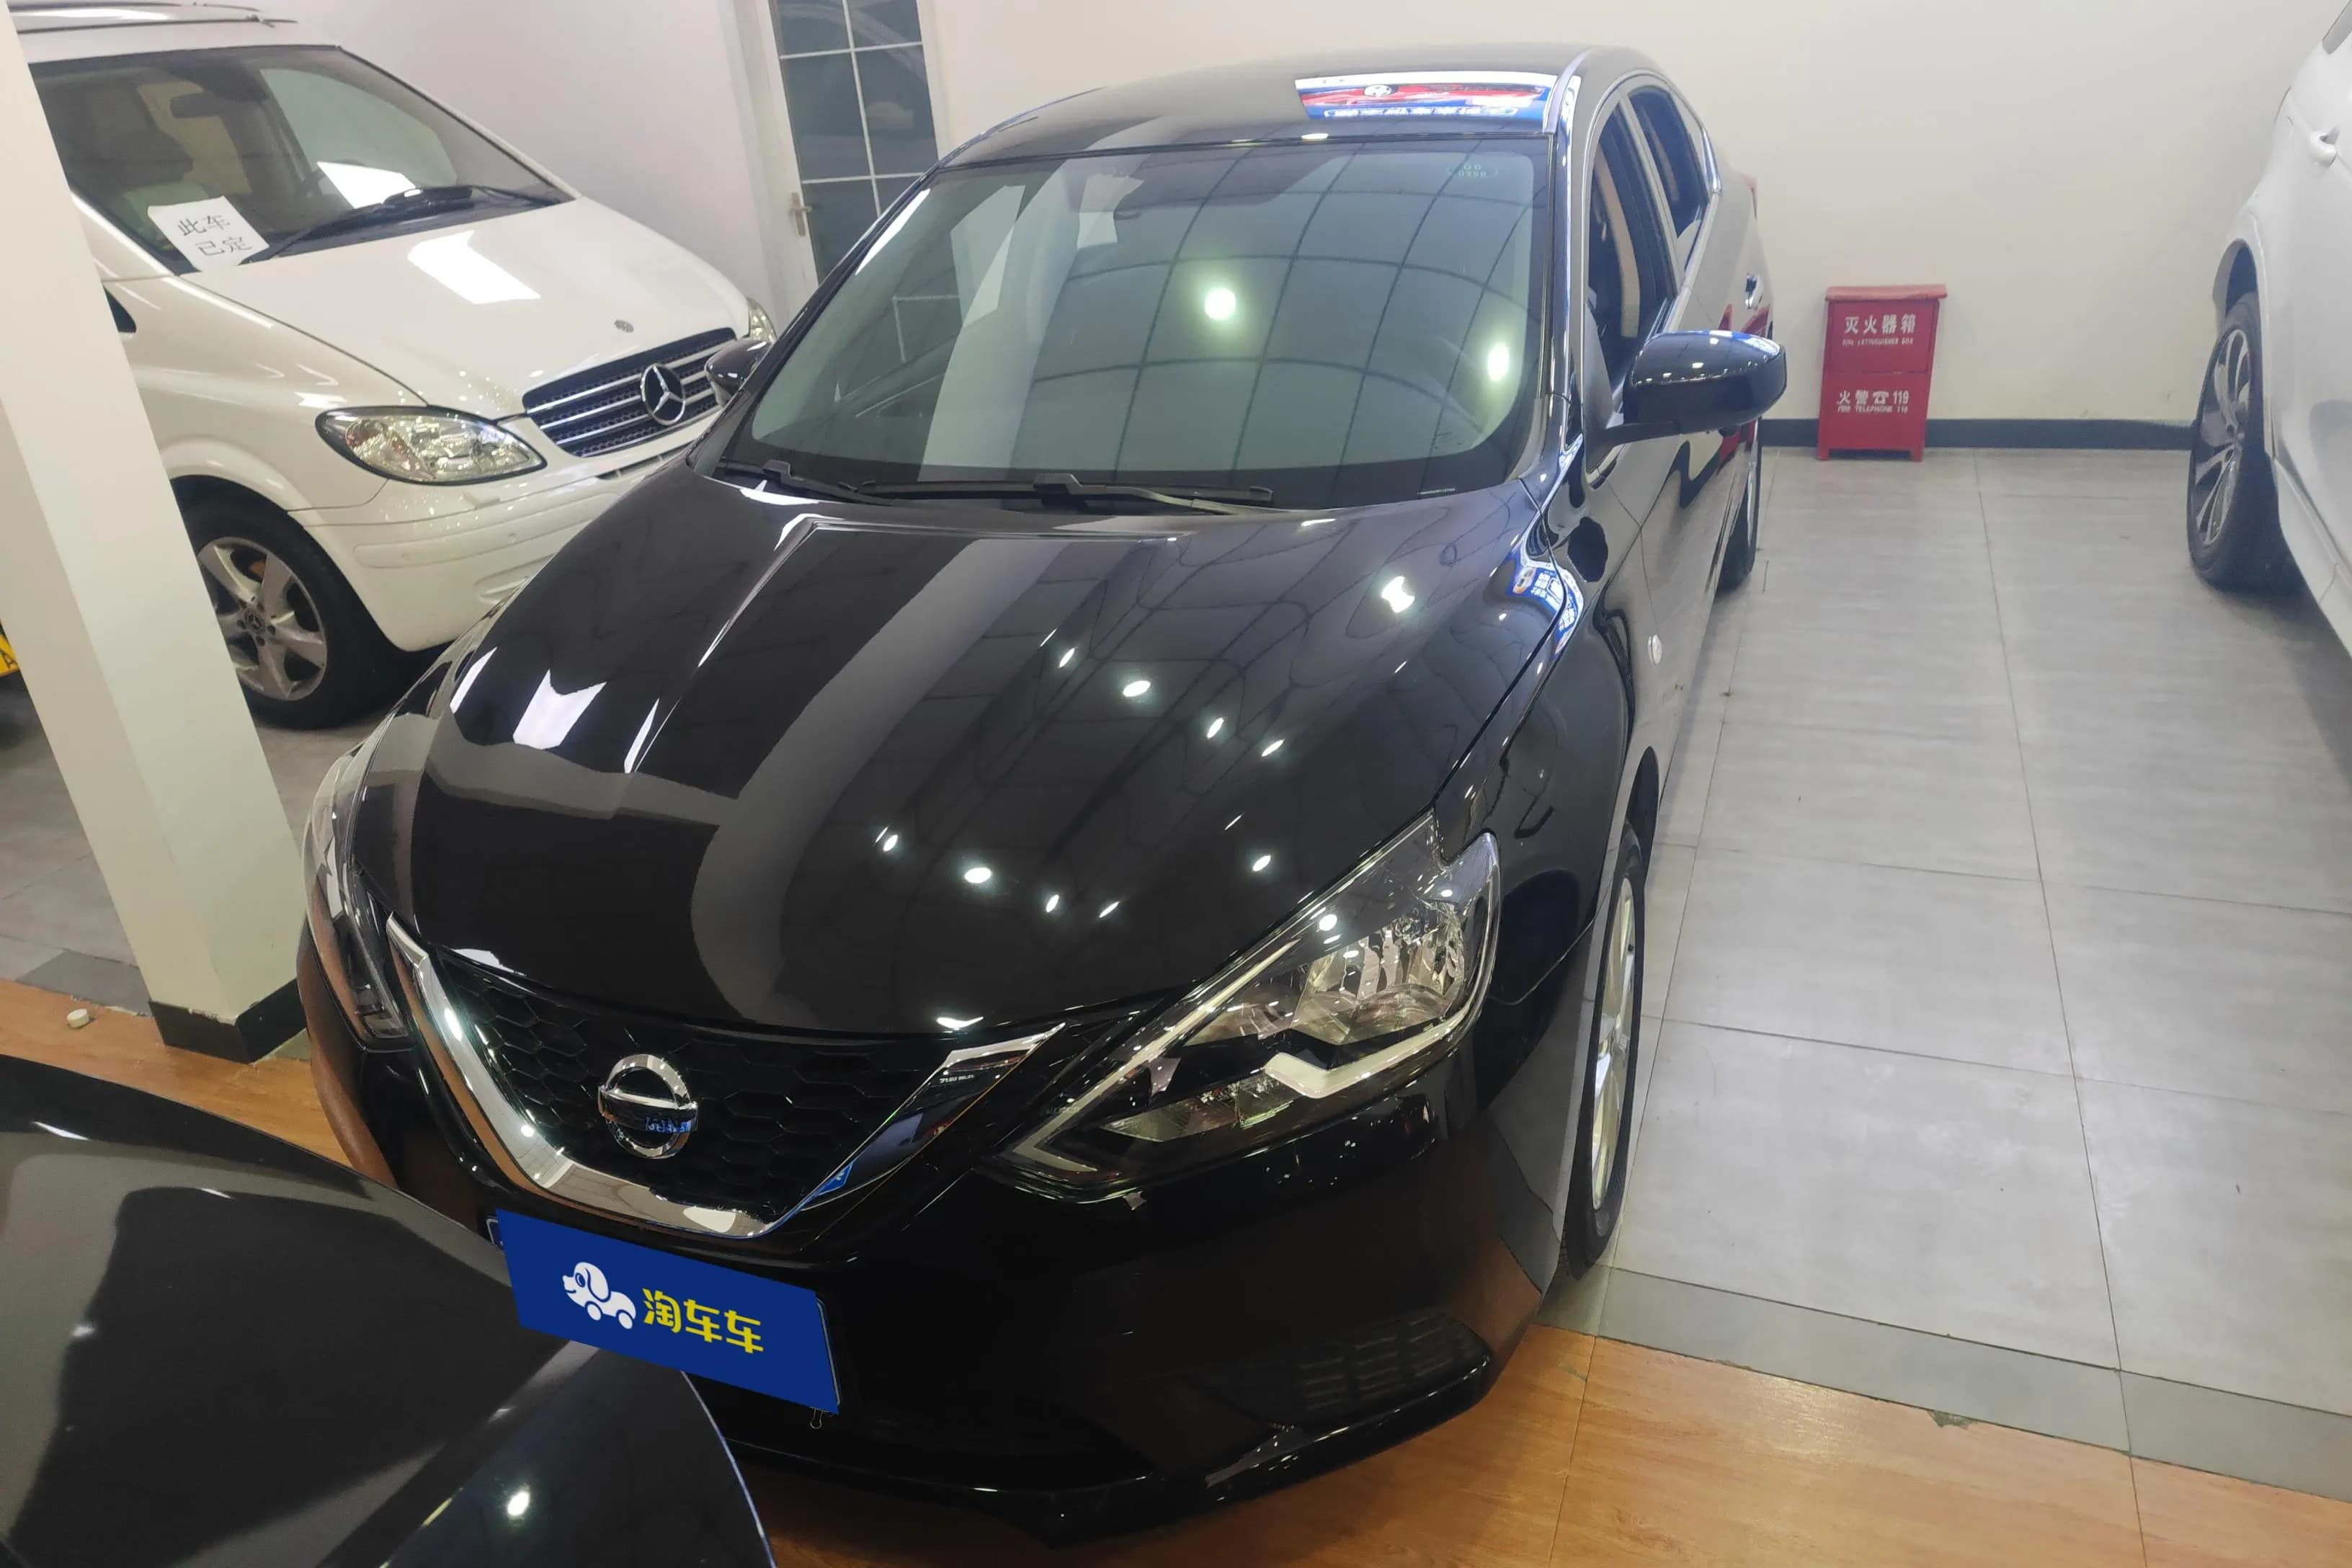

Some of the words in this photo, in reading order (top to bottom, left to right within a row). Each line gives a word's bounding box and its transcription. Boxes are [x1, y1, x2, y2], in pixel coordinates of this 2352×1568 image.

[178, 215, 231, 236] 此车
[195, 236, 253, 257] 已定
[1845, 313, 1916, 334] 灭火器箱
[1892, 390, 1909, 404] 119
